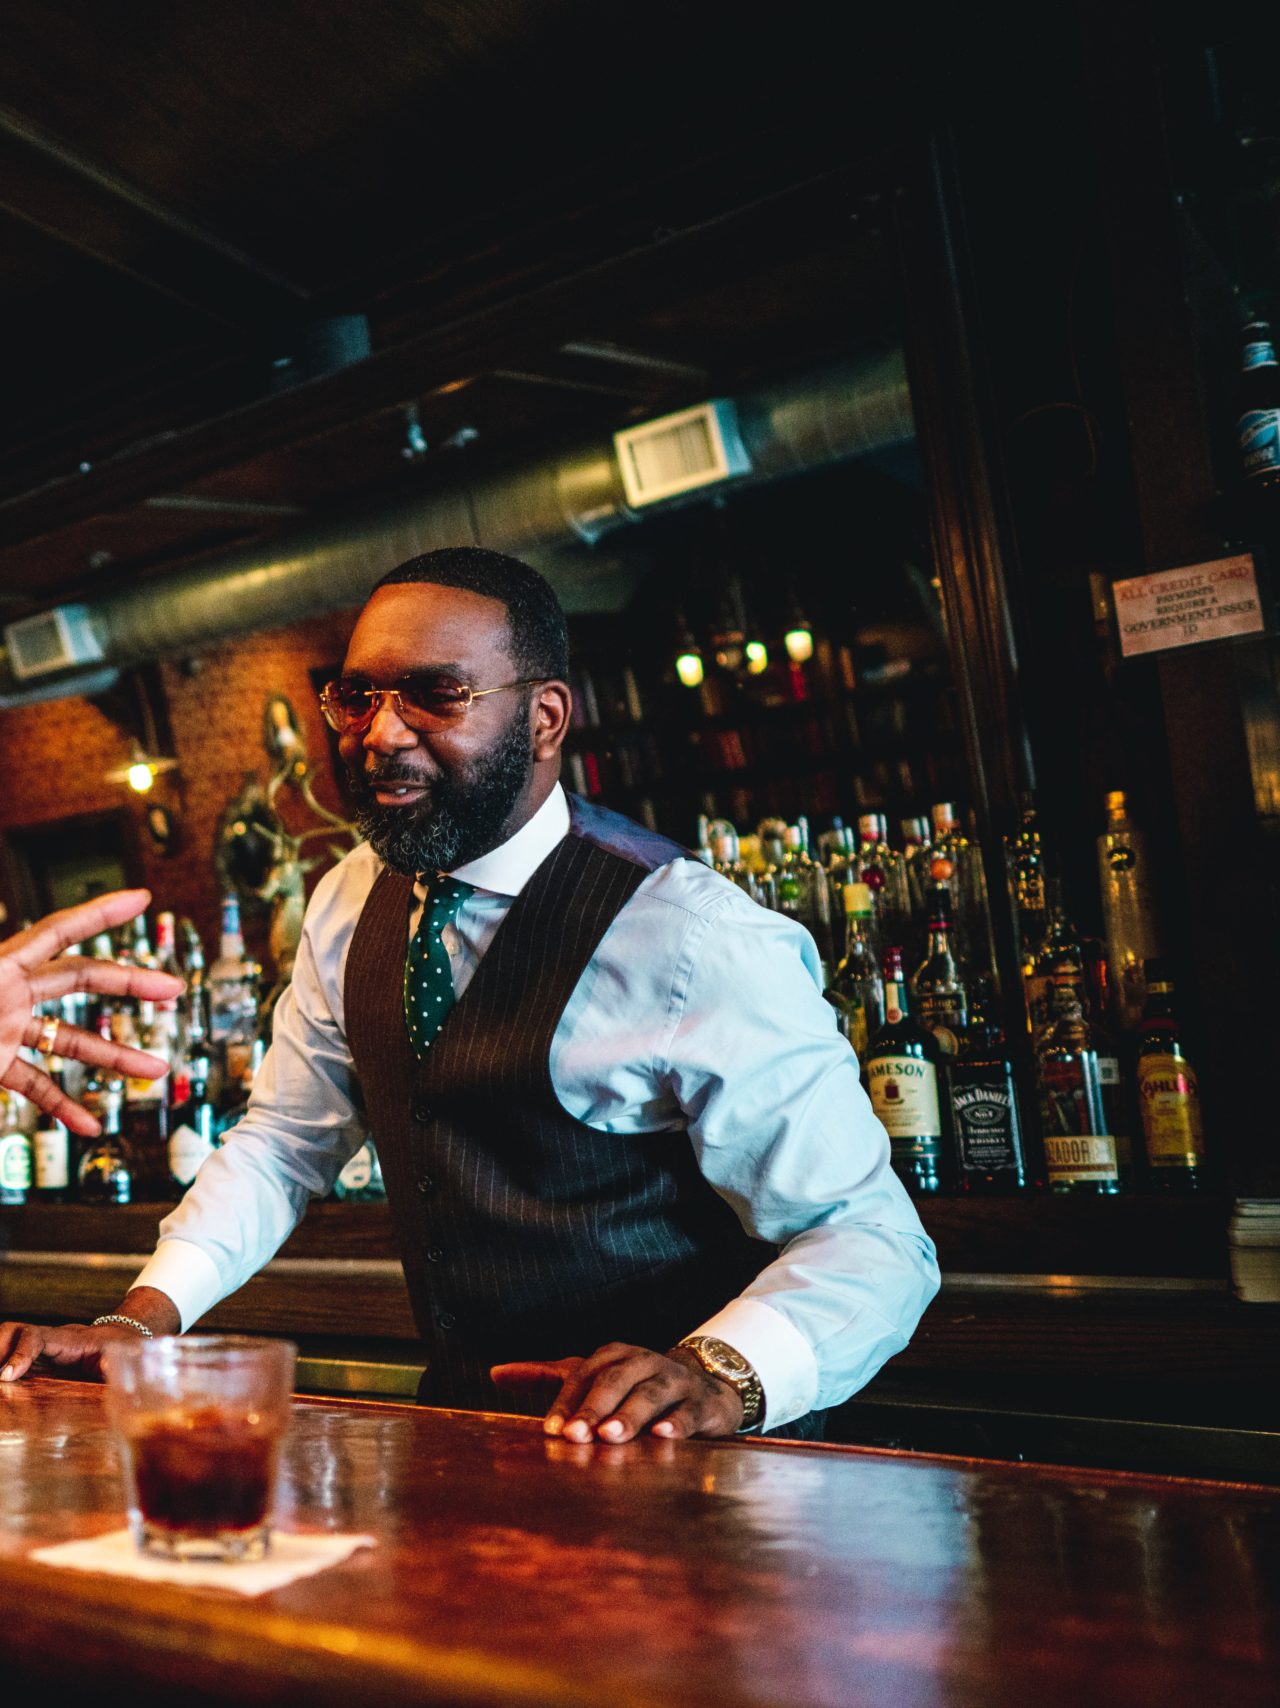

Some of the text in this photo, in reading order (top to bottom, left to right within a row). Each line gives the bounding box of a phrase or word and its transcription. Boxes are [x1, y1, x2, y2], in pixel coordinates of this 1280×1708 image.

[1121, 567, 1249, 600] ALL CREDIT CARD
[1157, 585, 1215, 604] PAYMENTS
[1124, 599, 1256, 633] GOVERNMENT ISSUE
[1156, 598, 1206, 615] REQUIRE
[869, 1062, 927, 1079] AMESON
